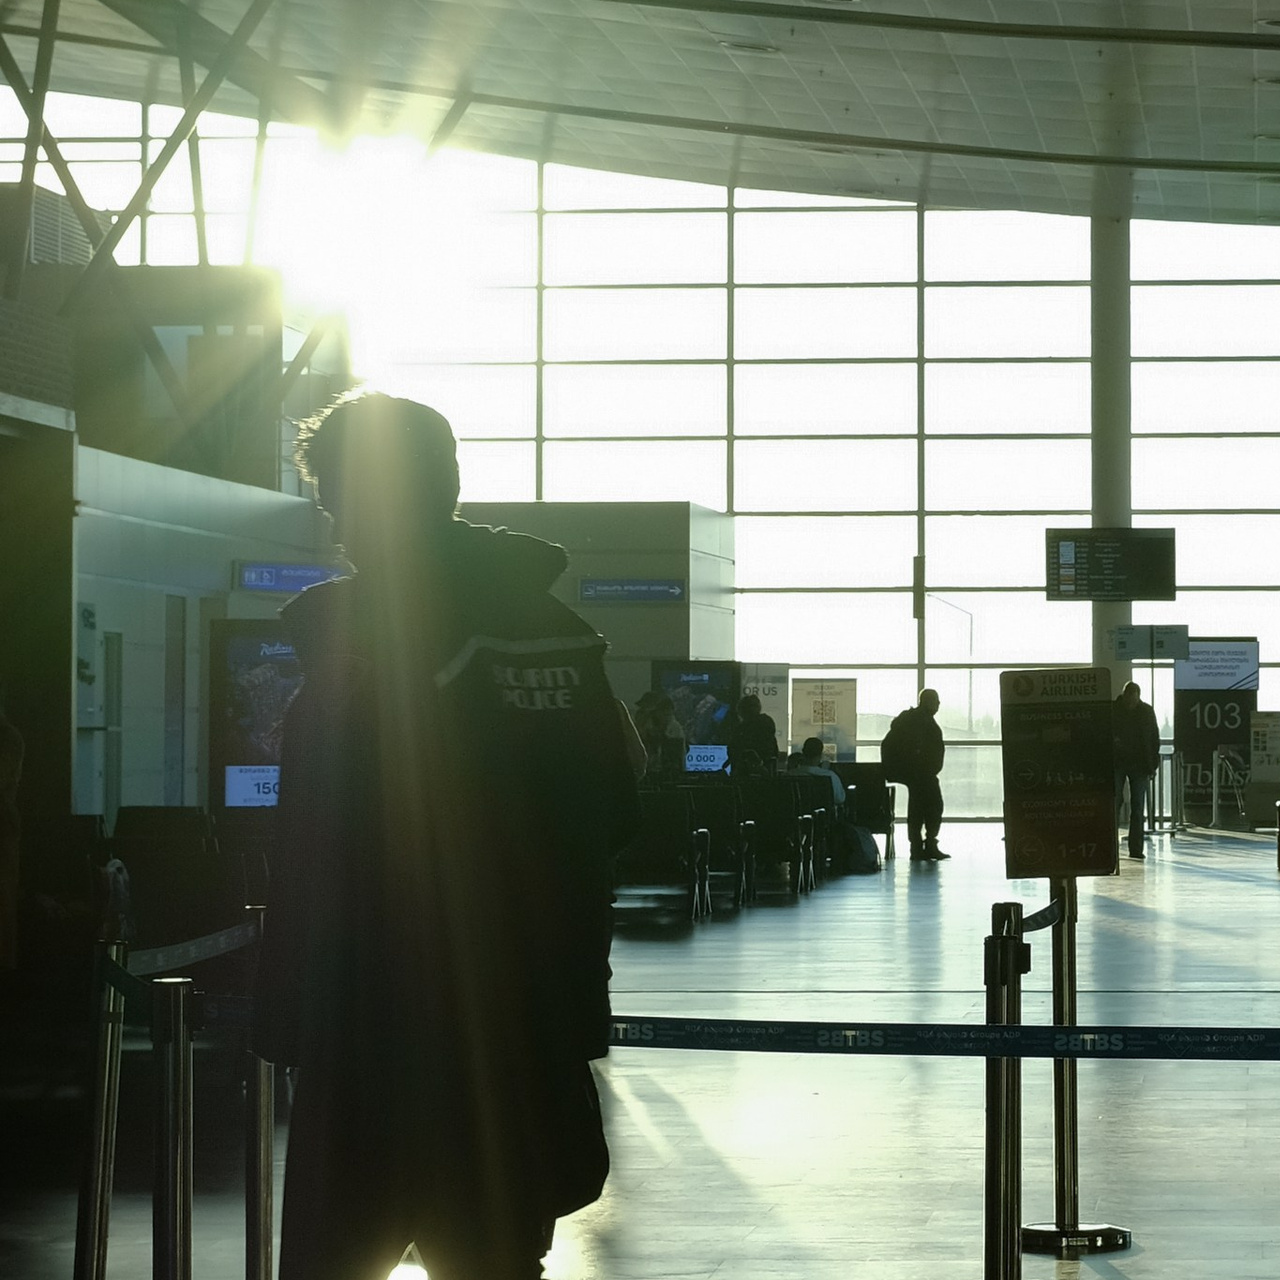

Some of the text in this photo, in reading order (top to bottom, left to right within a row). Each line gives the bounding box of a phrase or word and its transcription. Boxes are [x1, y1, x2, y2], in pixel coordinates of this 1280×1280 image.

[1041, 672, 1097, 685] TURKISH
[762, 686, 778, 697] US
[1041, 684, 1098, 697] AIRLINES
[1190, 702, 1242, 730] 103
[1056, 842, 1097, 858] 1-17
